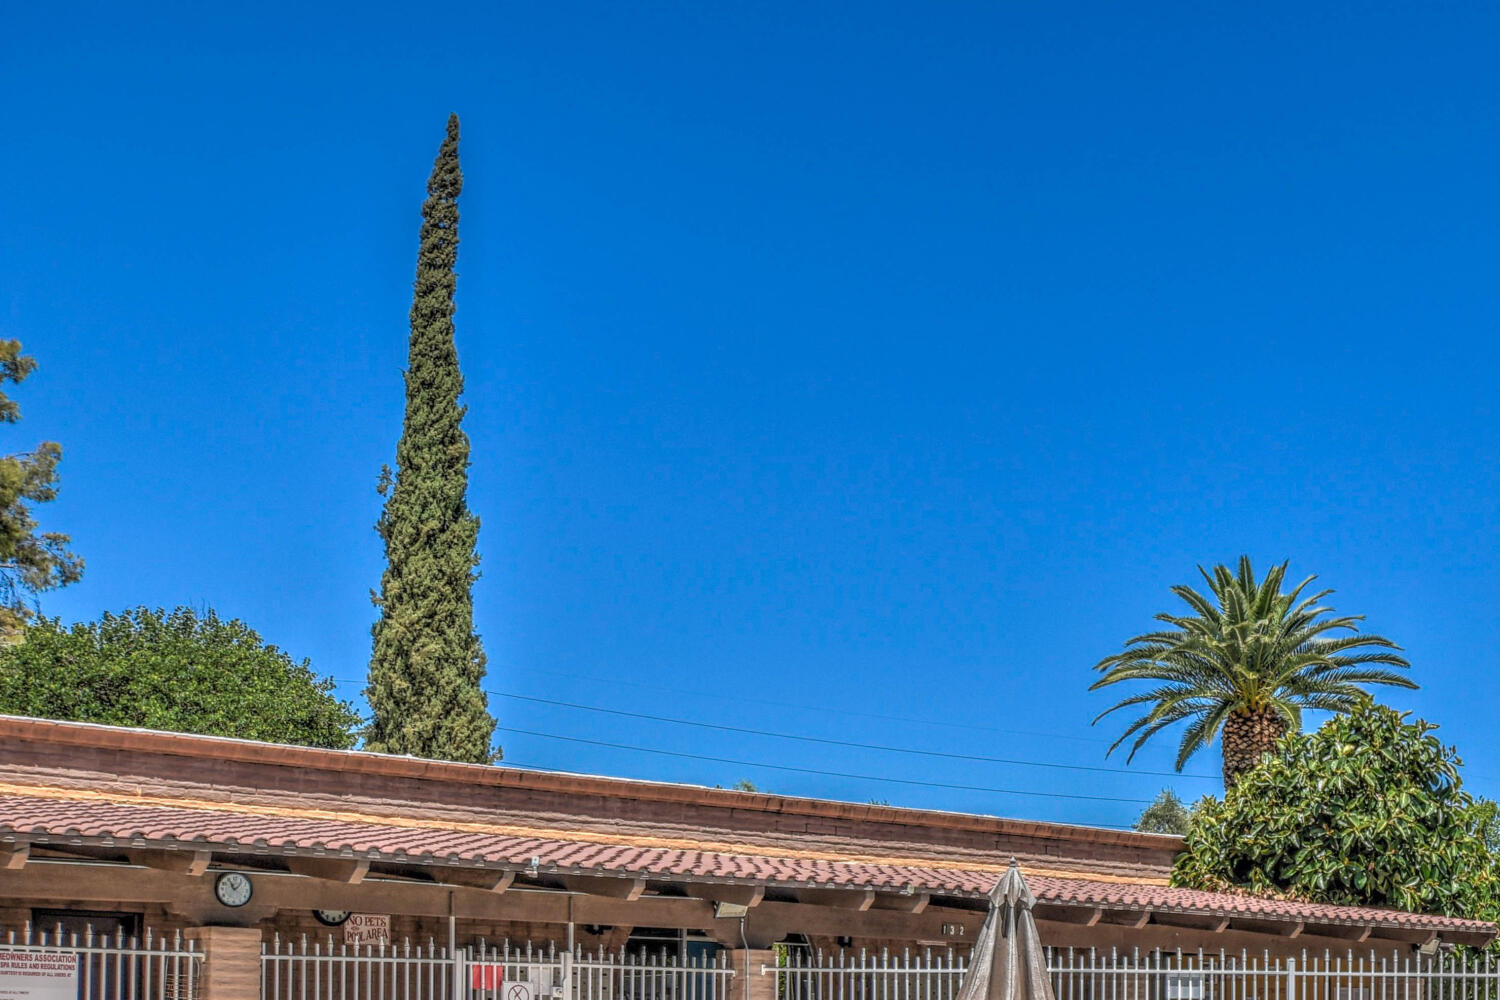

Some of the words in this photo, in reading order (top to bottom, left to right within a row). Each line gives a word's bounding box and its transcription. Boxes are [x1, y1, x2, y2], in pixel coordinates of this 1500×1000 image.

[346, 915, 363, 926] NO
[364, 916, 387, 927] PETS
[366, 927, 388, 941] AREA
[943, 925, 964, 936] 132
[0, 952, 33, 962] EOWNERS
[34, 953, 77, 964] ASSOCIATION
[11, 962, 28, 970] RULES
[40, 963, 76, 971] REGULATIONS
